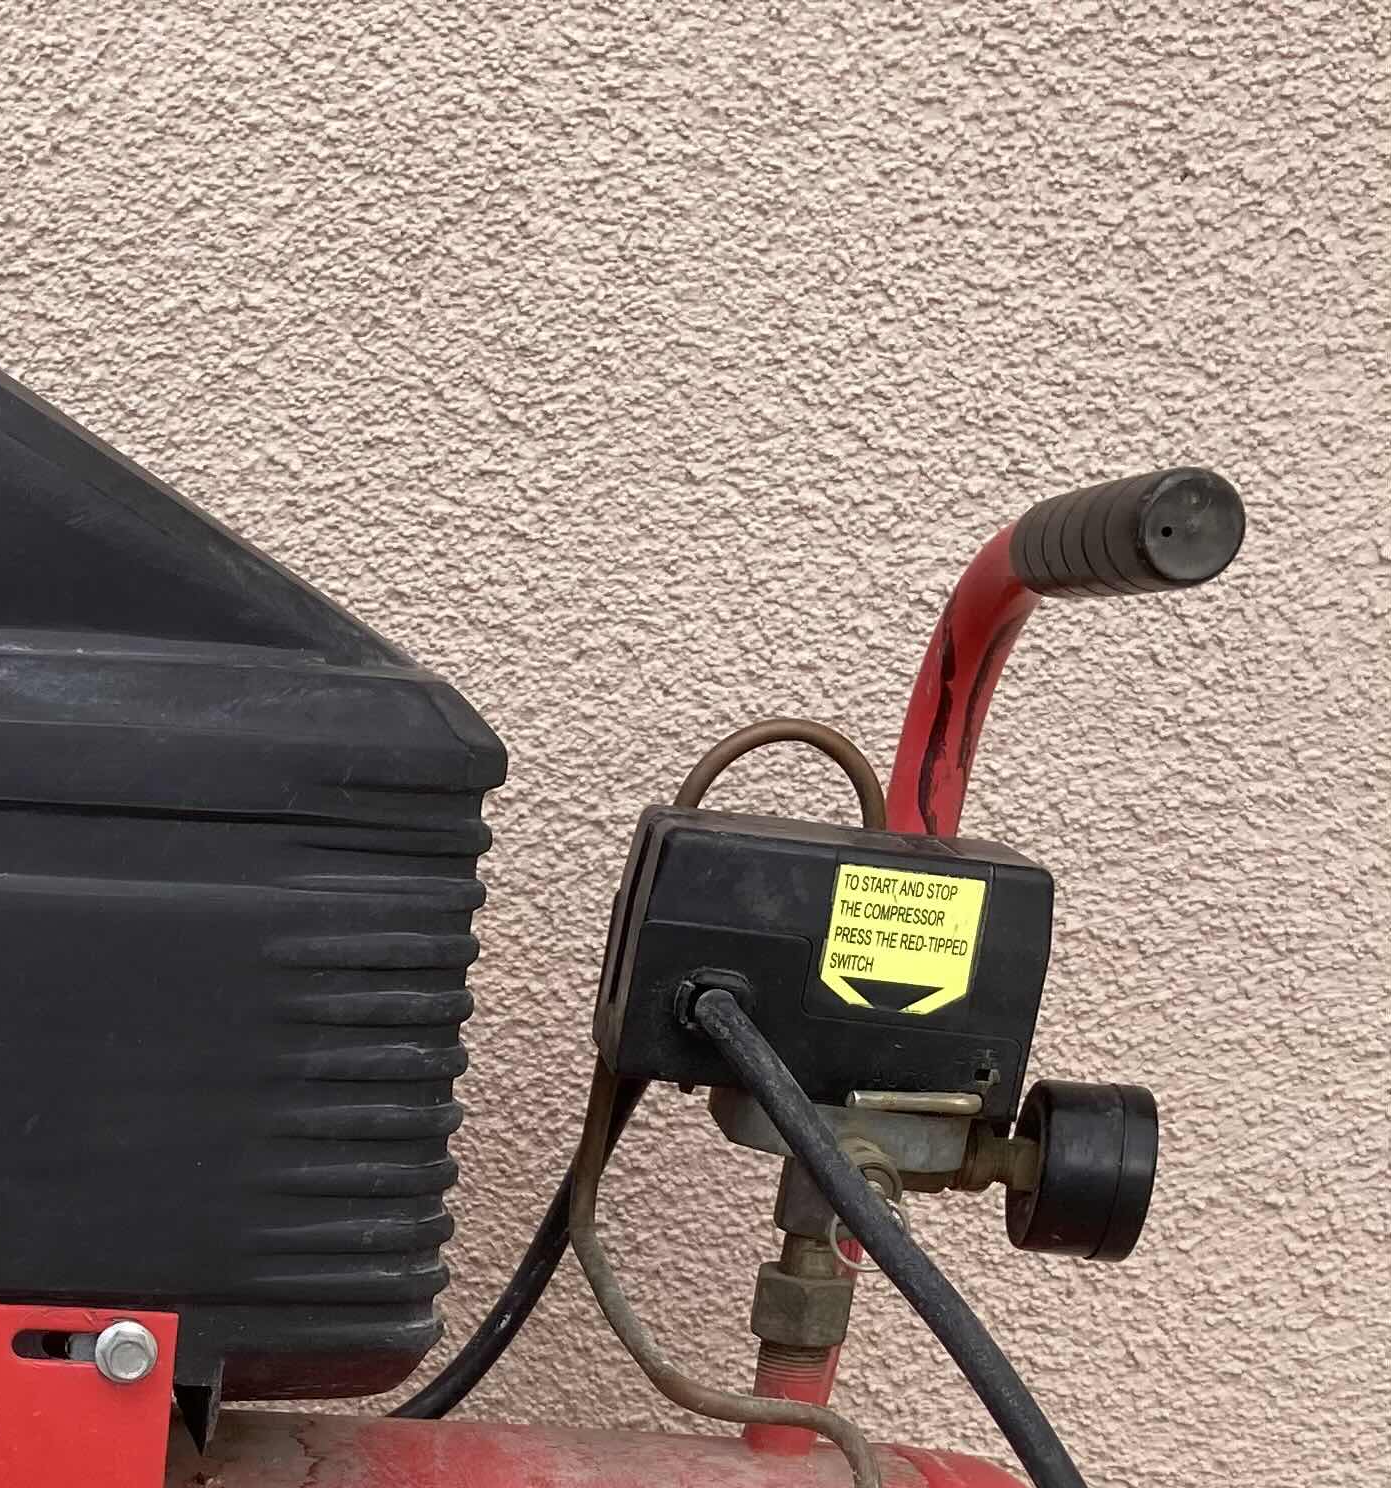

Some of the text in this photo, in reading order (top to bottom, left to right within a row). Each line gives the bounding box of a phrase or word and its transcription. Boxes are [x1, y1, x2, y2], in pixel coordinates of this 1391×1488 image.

[844, 873, 958, 901] TO START AND STOP
[840, 900, 945, 926] THE COMPRESSOR
[834, 926, 968, 956] PRESS THE RED-TIPPED
[829, 952, 874, 972] SWITCH
